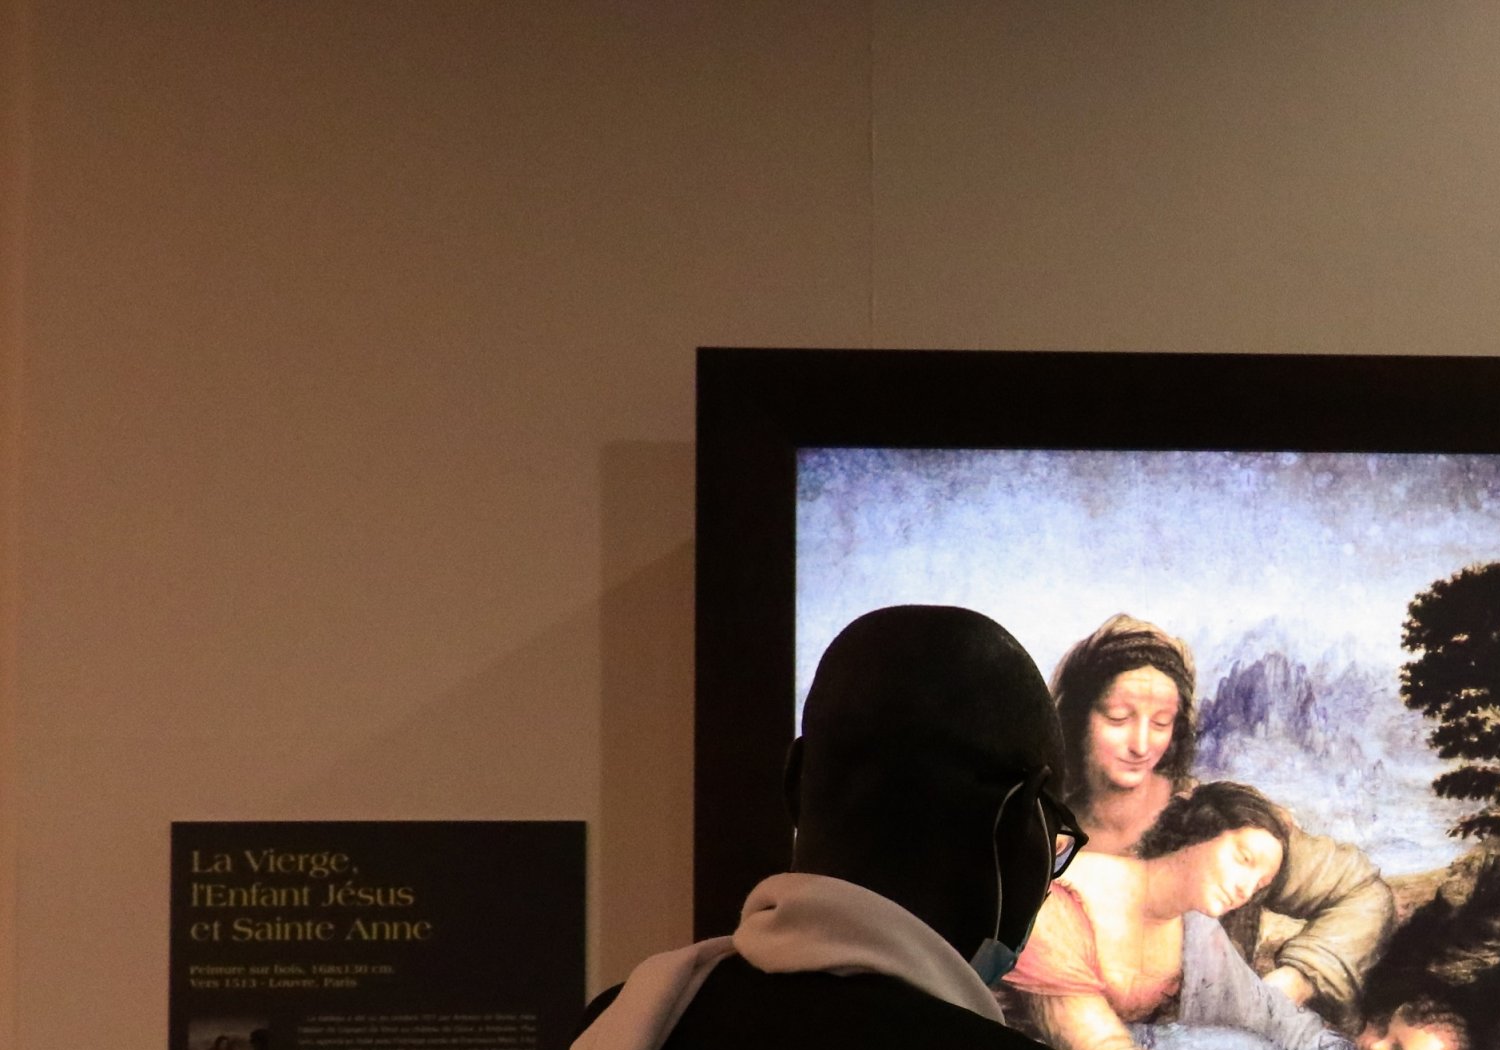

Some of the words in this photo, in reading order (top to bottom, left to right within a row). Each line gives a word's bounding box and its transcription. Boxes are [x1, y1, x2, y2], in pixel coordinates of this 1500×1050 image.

[191, 850, 232, 874] La
[244, 848, 359, 879] Vierge,
[191, 881, 309, 908] l'Enfant
[321, 881, 415, 909] Jésus
[190, 921, 221, 942] et
[231, 917, 334, 943] Sainte
[345, 917, 432, 942] Anne
[189, 978, 219, 990] Vers
[323, 977, 357, 989] Paris
[248, 966, 269, 976] sur
